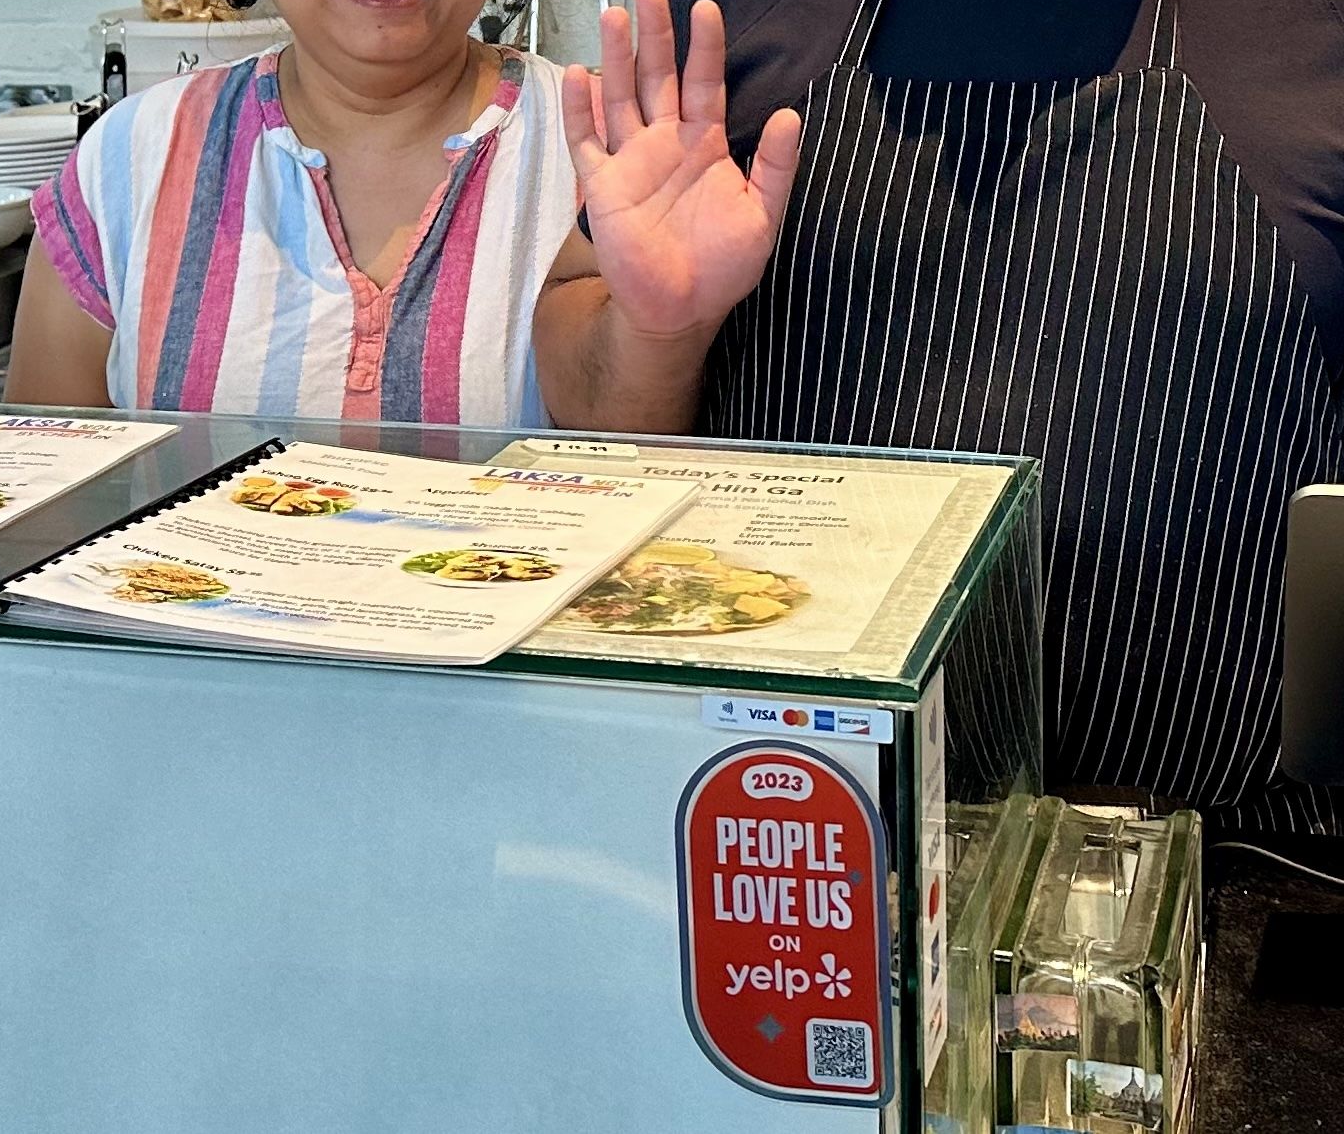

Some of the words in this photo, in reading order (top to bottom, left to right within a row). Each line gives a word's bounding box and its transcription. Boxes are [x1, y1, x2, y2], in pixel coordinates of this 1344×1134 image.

[78, 423, 129, 433] NOLA
[261, 469, 301, 480] Yahoo
[331, 481, 358, 490] Roll
[483, 468, 585, 484] LAKSA
[590, 478, 645, 488] NOLA
[642, 466, 738, 480] Today's
[745, 472, 845, 484] Special
[554, 487, 599, 495] CHEF
[711, 482, 757, 496] Hin
[765, 486, 805, 497] Ga
[806, 499, 836, 507] Dish
[750, 520, 796, 528] Green
[755, 512, 788, 520] Rice
[788, 514, 849, 523] noodles
[738, 532, 775, 540] Lime
[743, 526, 801, 534] Sprouts
[770, 539, 815, 547] flakes
[122, 543, 179, 562] Chicken
[184, 558, 221, 572] Satay
[747, 708, 777, 722] VISA
[751, 772, 804, 793] 2023
[714, 816, 846, 874] PEOPLE
[711, 871, 800, 927] LOVE
[807, 878, 854, 931] US
[768, 934, 802, 953] ON
[725, 959, 811, 1000] yelp
